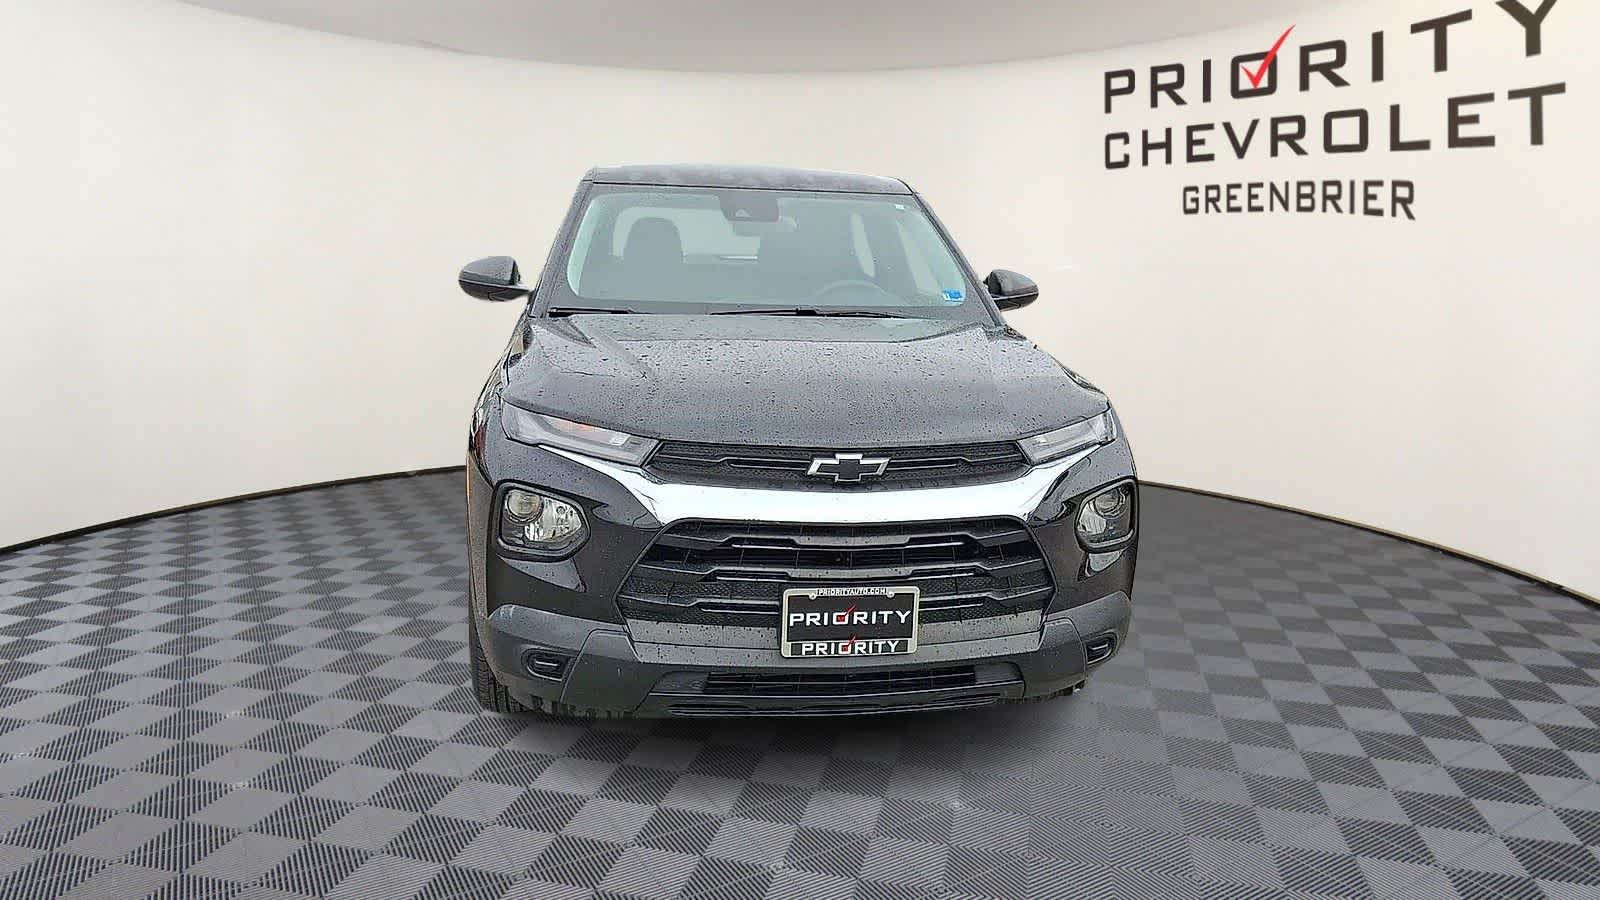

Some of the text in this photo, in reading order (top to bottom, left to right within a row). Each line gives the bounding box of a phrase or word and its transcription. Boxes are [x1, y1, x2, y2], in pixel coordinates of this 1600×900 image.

[1104, 0, 1557, 114] PRIORITY
[1104, 82, 1566, 170] CHEVROLET
[1182, 180, 1416, 220] GREENBRIER
[818, 587, 886, 596] PRIORITYAUTO.COM
[789, 610, 912, 626] PRIORITY
[801, 641, 900, 655] PRIORITY
